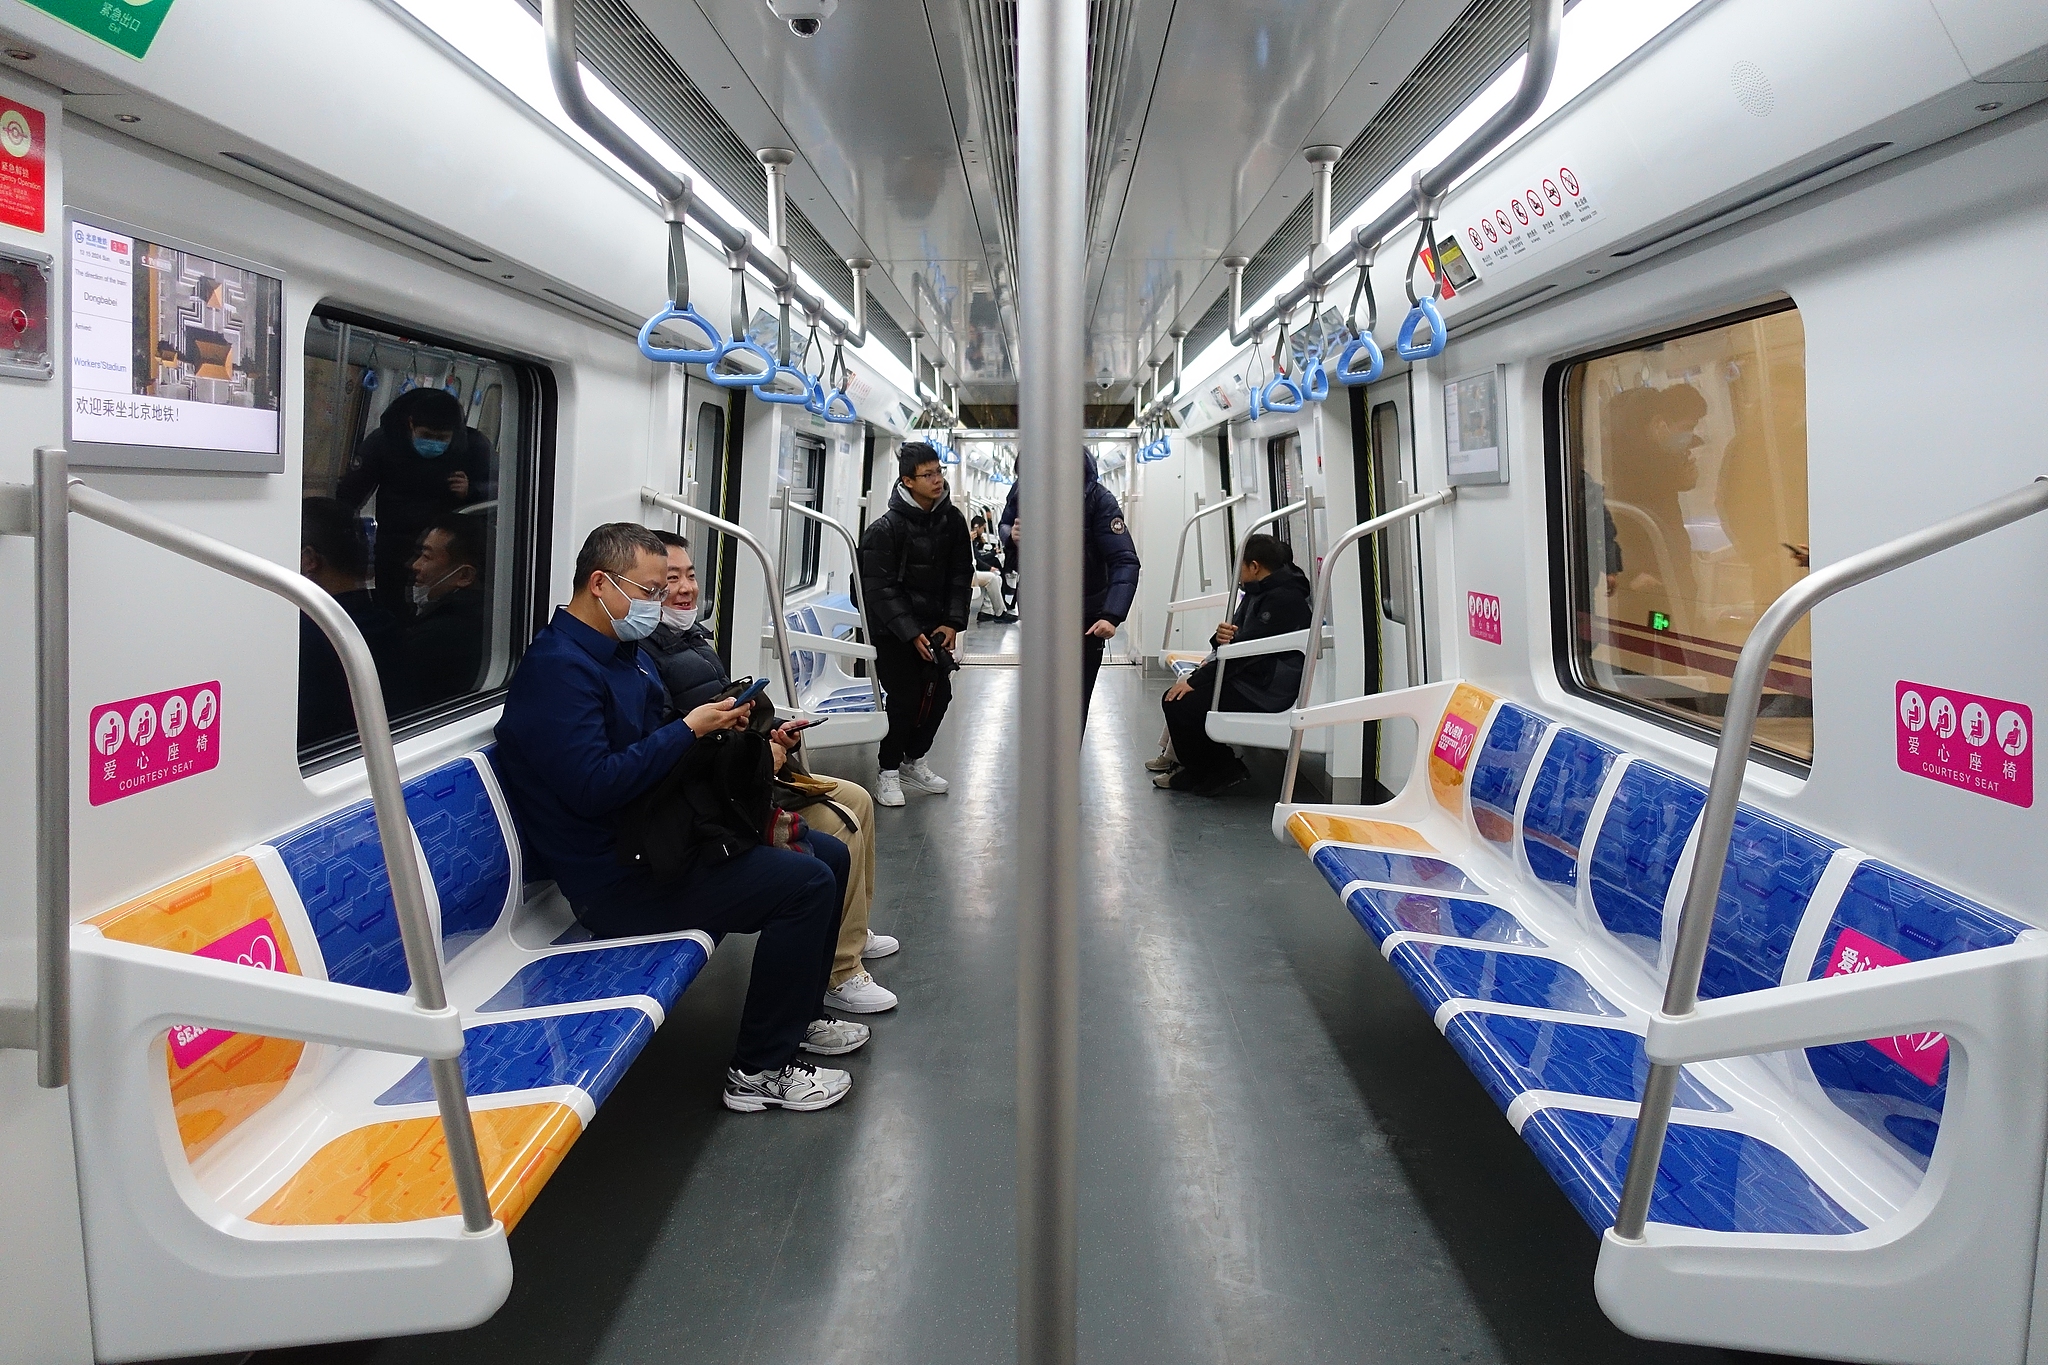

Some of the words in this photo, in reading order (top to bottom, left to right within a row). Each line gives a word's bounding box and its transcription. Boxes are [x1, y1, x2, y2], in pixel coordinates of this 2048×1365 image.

[100, 2, 140, 32] 紧急出口
[75, 268, 84, 276] The
[85, 271, 103, 281] direction
[83, 292, 118, 307] Dongbabei
[76, 396, 180, 423] 欢迎乘坐北京地铁！
[103, 734, 208, 781] 爱心座椅
[1908, 736, 2017, 782] 爱心座椅
[119, 768, 169, 791] COURTESY
[172, 760, 194, 775] SEAT
[1922, 761, 1971, 784] COURTESY
[1974, 776, 1999, 792] SEAT
[176, 1026, 209, 1047] SEA
